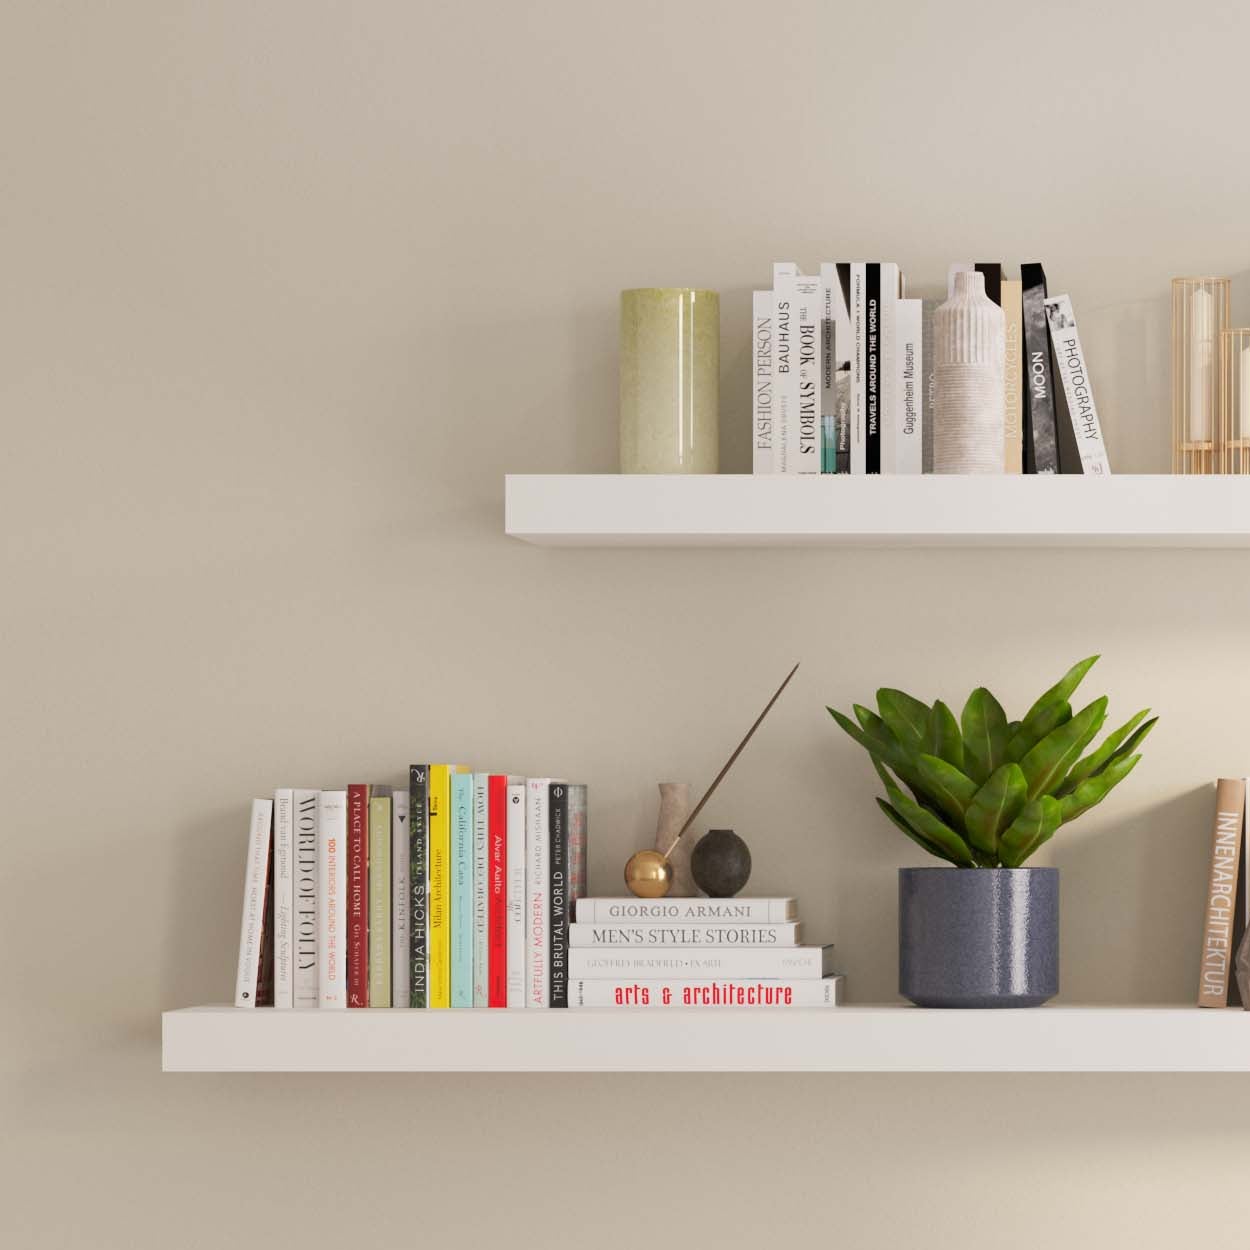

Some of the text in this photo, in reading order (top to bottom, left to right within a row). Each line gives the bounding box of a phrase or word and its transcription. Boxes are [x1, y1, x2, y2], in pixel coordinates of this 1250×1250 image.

[779, 301, 790, 373] BAUHAUS
[800, 325, 815, 366] BOOK
[824, 288, 832, 389] MODERN ARCHITECTURE
[757, 317, 772, 449] FASHION PERSON
[869, 299, 877, 436] TRAVELS AROUND THE WORLD
[904, 343, 916, 435] Guggenheim Museum
[1031, 351, 1045, 399] MOON
[1063, 338, 1100, 442] PHOTOGRAPHY
[800, 382, 815, 454] SYMBOLS
[353, 791, 361, 917] A PLACE TO CALL HOME
[416, 838, 424, 875] ISLAND
[458, 806, 467, 858] California
[494, 834, 503, 862] Alvar
[299, 797, 316, 971] WORLD OF FOLLY
[433, 849, 441, 901] Architecture
[458, 861, 467, 886] Casa
[494, 864, 503, 894] Aalto
[553, 871, 563, 917] WORLD
[328, 838, 336, 981] 100 INTERIORS AROUND THE WORLD
[415, 885, 425, 939] HICKS
[433, 904, 441, 929] Milan
[533, 893, 542, 947] MODERN
[609, 905, 751, 917] GIORGIO ARMANI
[1202, 811, 1240, 997] INNENARCHITEKTUR
[553, 920, 563, 967] BRUTAL
[592, 929, 777, 943] MEN'S STYLE STORIES
[415, 945, 425, 993] INDIA
[533, 952, 542, 1004] ARTFULLY
[553, 971, 563, 1001] THIS
[614, 982, 793, 1005] arts & architecture
